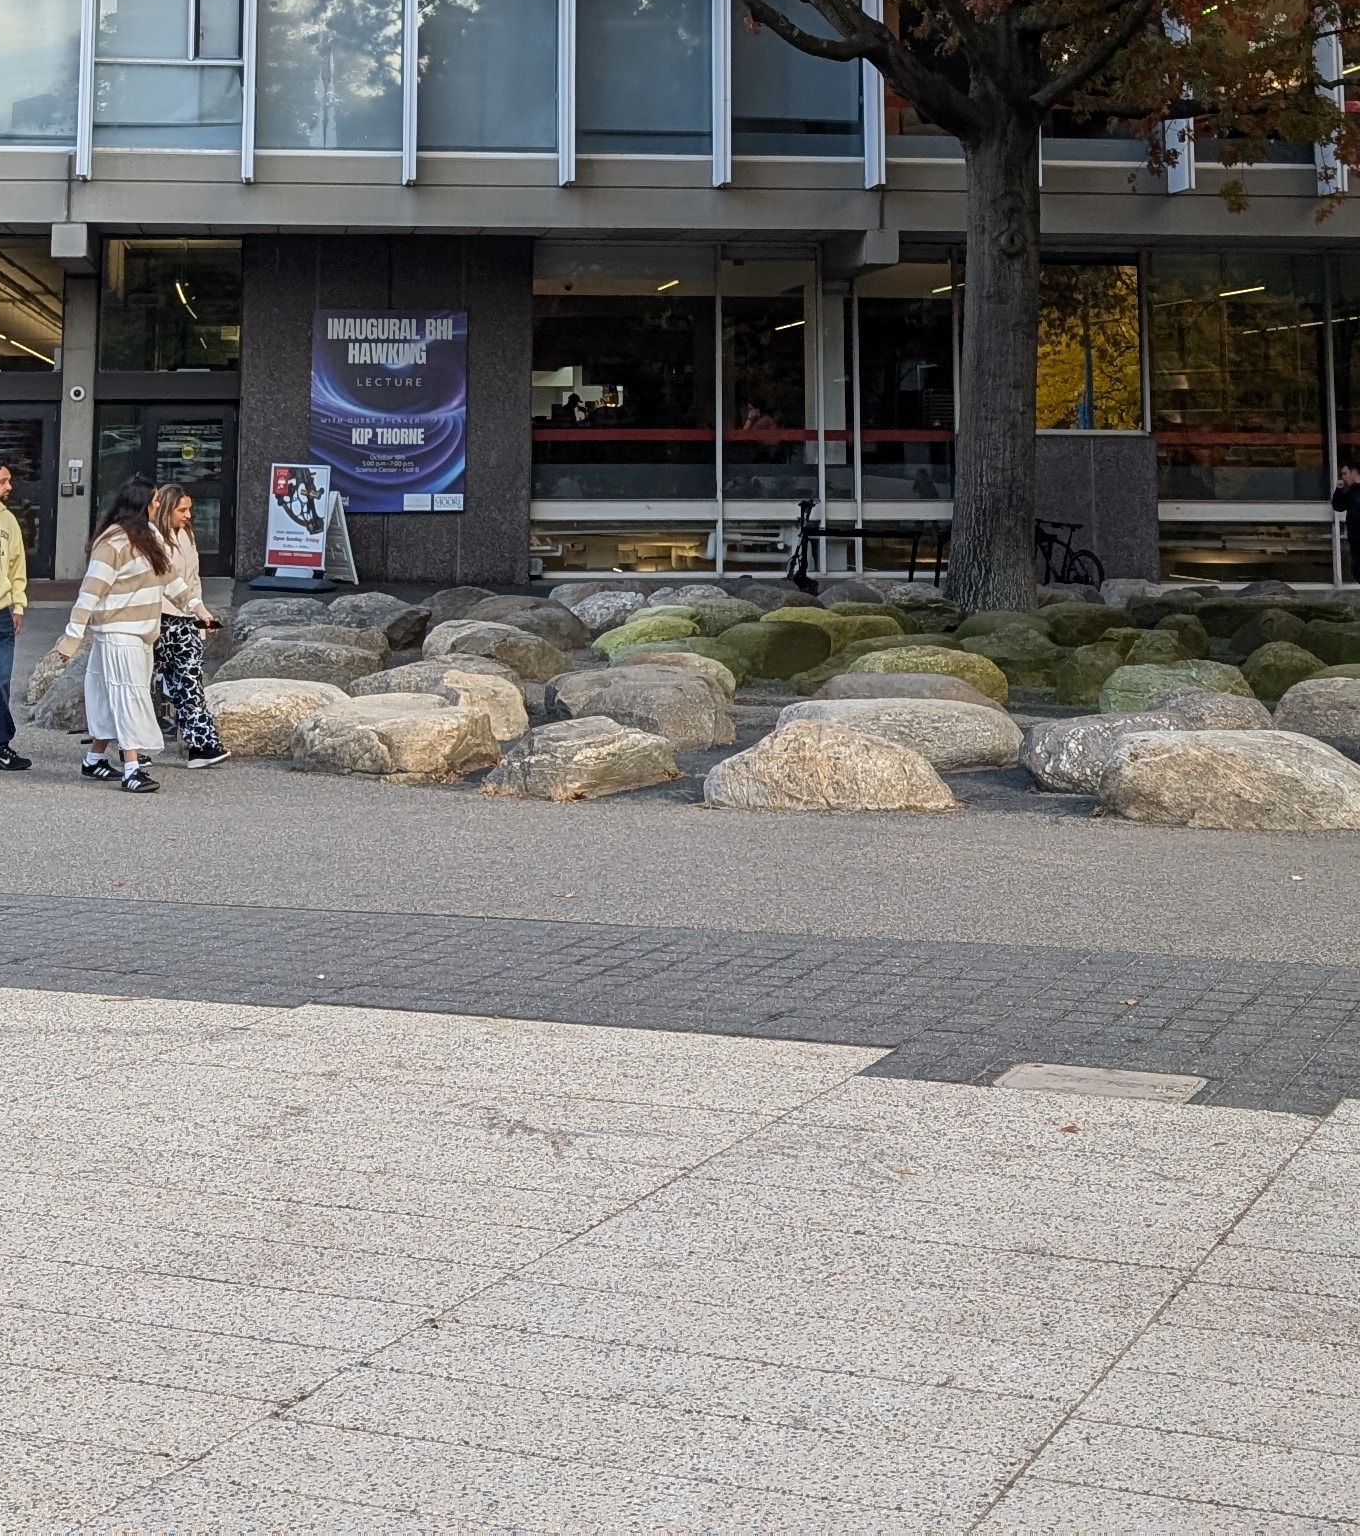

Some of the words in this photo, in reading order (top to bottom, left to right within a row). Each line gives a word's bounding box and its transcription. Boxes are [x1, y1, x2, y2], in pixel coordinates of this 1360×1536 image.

[327, 318, 420, 340] INAUGURAL
[425, 318, 453, 340] BHI
[347, 342, 427, 365] HAWKING
[356, 377, 422, 387] LECTURE
[351, 427, 373, 445] KIP
[376, 427, 425, 445] THORNE
